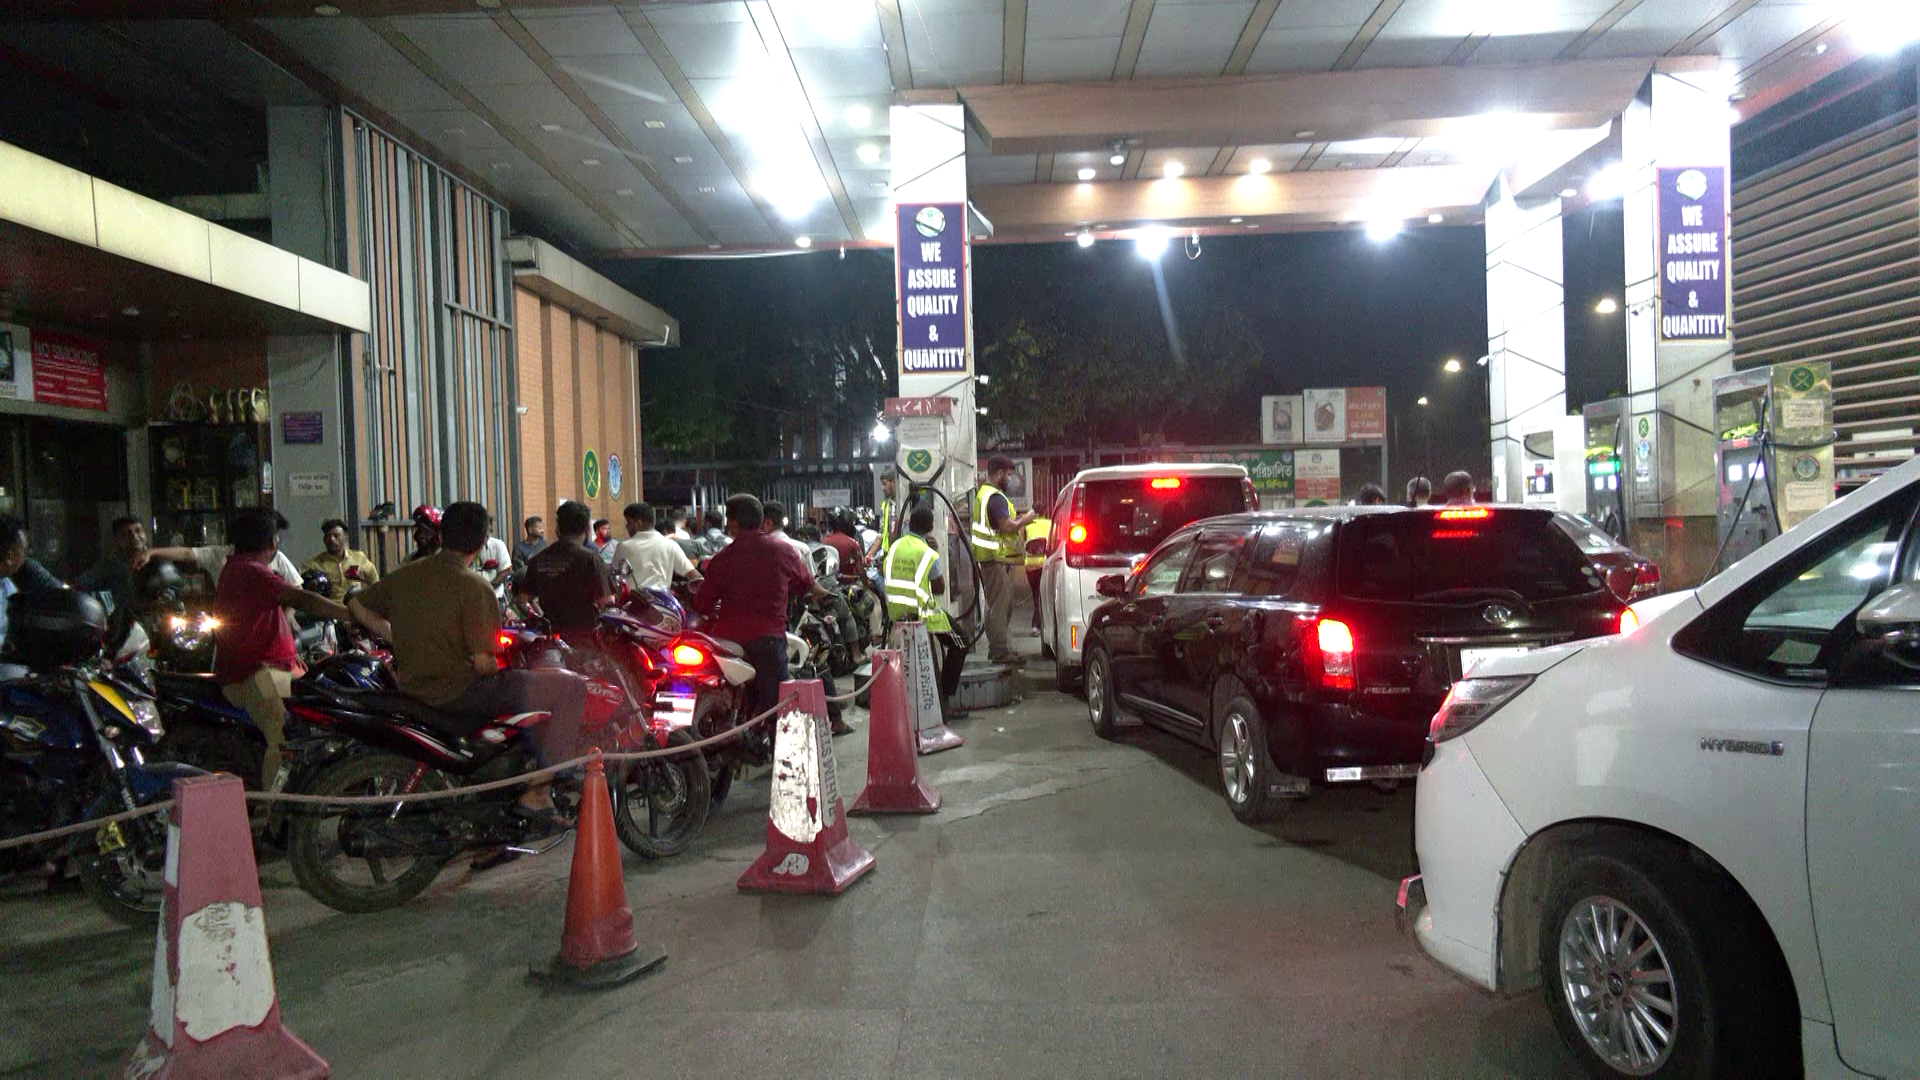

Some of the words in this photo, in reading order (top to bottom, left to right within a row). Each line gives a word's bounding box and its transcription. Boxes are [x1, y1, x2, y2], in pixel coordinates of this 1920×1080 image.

[1681, 205, 1703, 227] WE
[920, 241, 942, 263] WE
[1667, 232, 1719, 254] ASSURE
[907, 268, 957, 289] ASSURE
[1666, 260, 1720, 284] QUALITY
[907, 295, 959, 318] QUALITY
[1687, 288, 1699, 309] &
[928, 324, 939, 342] &
[1662, 314, 1726, 338] QUANTITY
[34, 341, 50, 357] NO
[53, 343, 99, 366] SMOKING
[904, 347, 965, 370] QUANTITY
